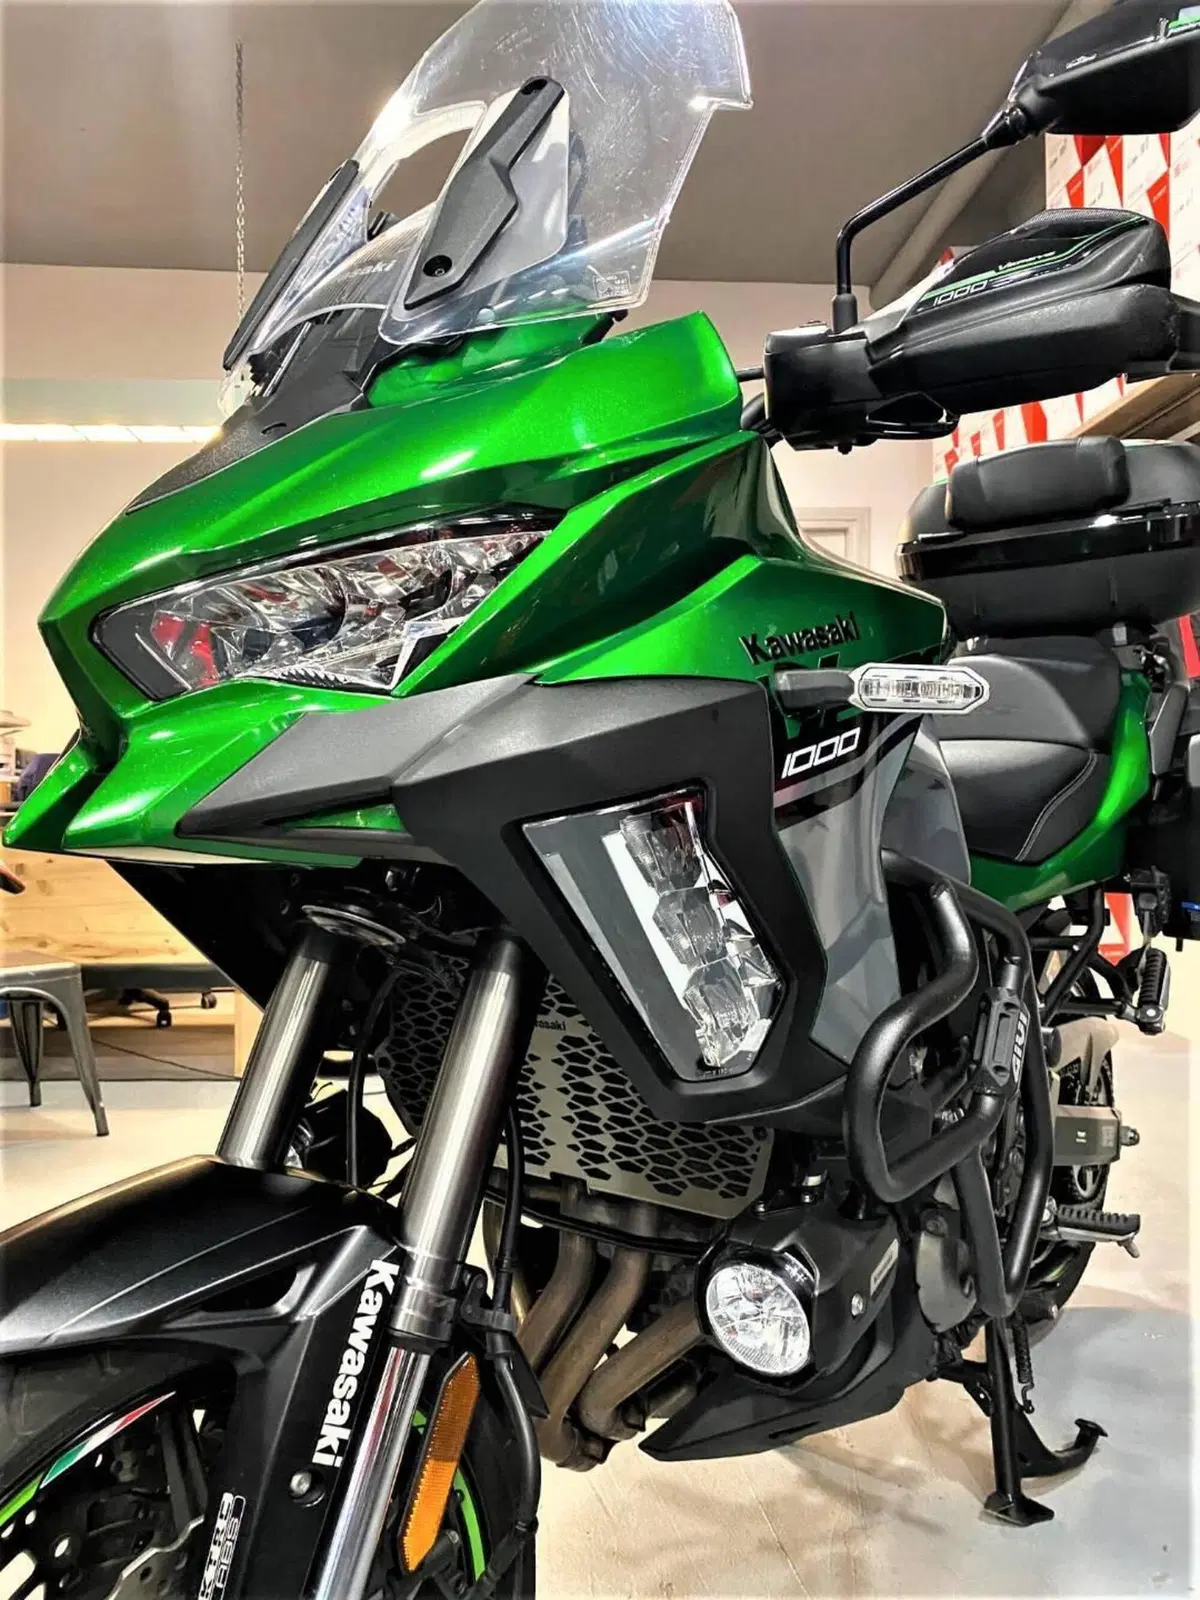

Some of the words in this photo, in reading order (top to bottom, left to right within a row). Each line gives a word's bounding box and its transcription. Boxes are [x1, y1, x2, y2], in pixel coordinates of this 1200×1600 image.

[932, 279, 988, 306] 1000
[739, 611, 860, 665] Kawasaki
[781, 727, 861, 779] 1000
[536, 1020, 566, 1031] asaki
[311, 1259, 400, 1468] Kawasaki
[215, 1517, 240, 1589] ABS
